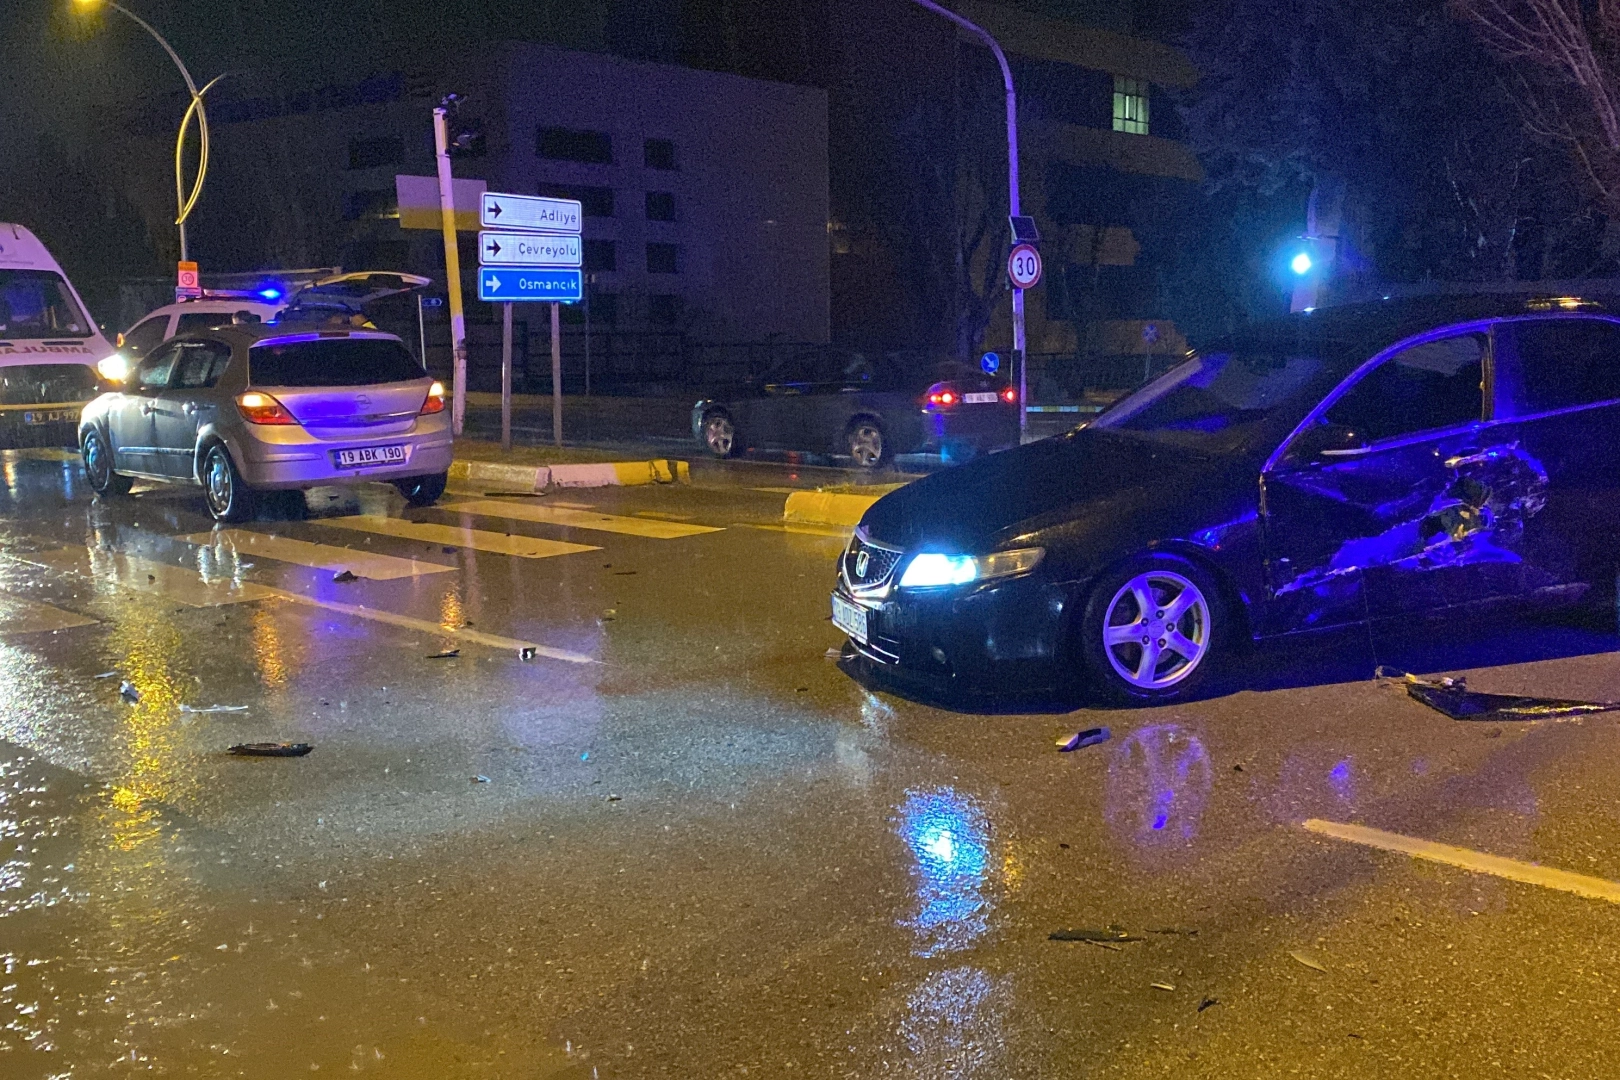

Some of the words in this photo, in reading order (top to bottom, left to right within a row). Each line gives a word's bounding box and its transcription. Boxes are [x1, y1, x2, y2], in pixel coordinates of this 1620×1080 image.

[540, 209, 577, 225] Adliye
[518, 243, 577, 258] Çevreyolu
[1016, 256, 1035, 276] 30
[341, 451, 355, 463] 19
[359, 449, 378, 462] ABK
[382, 447, 401, 459] 190
